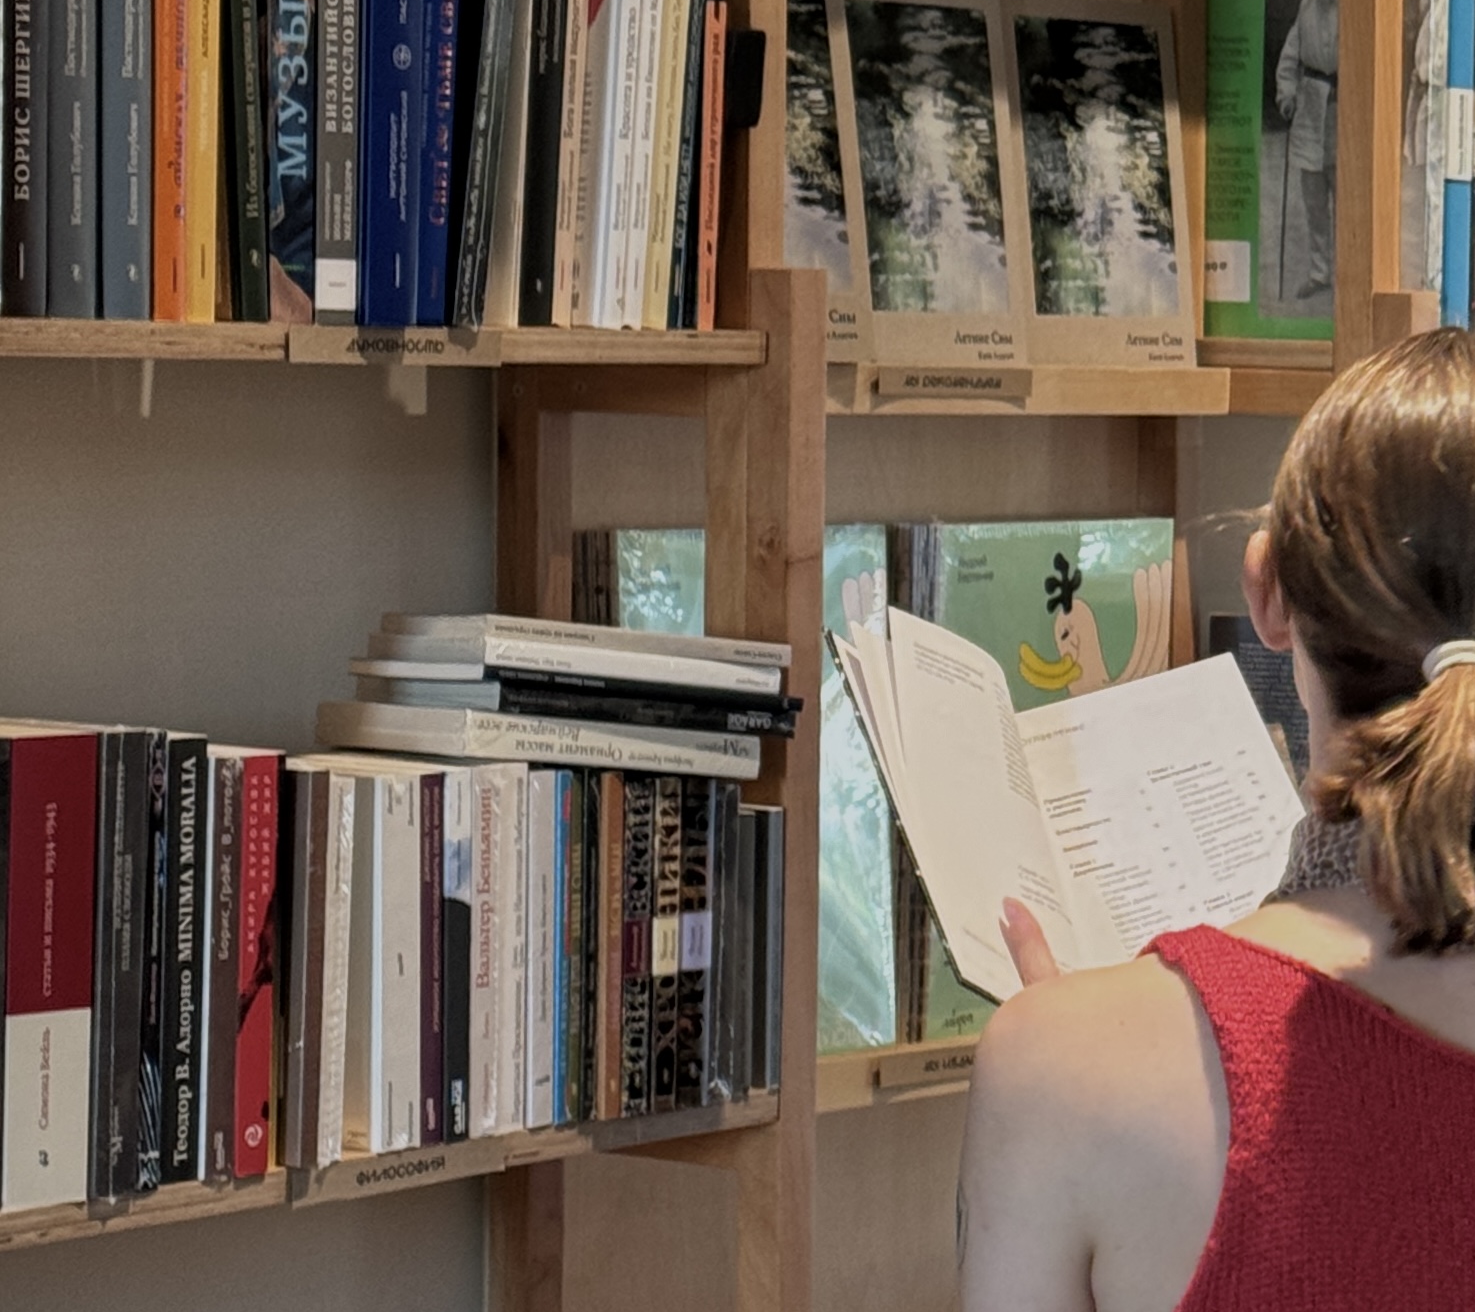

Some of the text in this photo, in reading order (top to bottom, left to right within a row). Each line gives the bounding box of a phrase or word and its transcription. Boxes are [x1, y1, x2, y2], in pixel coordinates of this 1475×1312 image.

[13, 106, 32, 202] БОРИС
[172, 755, 198, 1167] Теодор В. Адорно MINIMA MORALIA
[475, 786, 494, 990] Вальтер Беньямин
